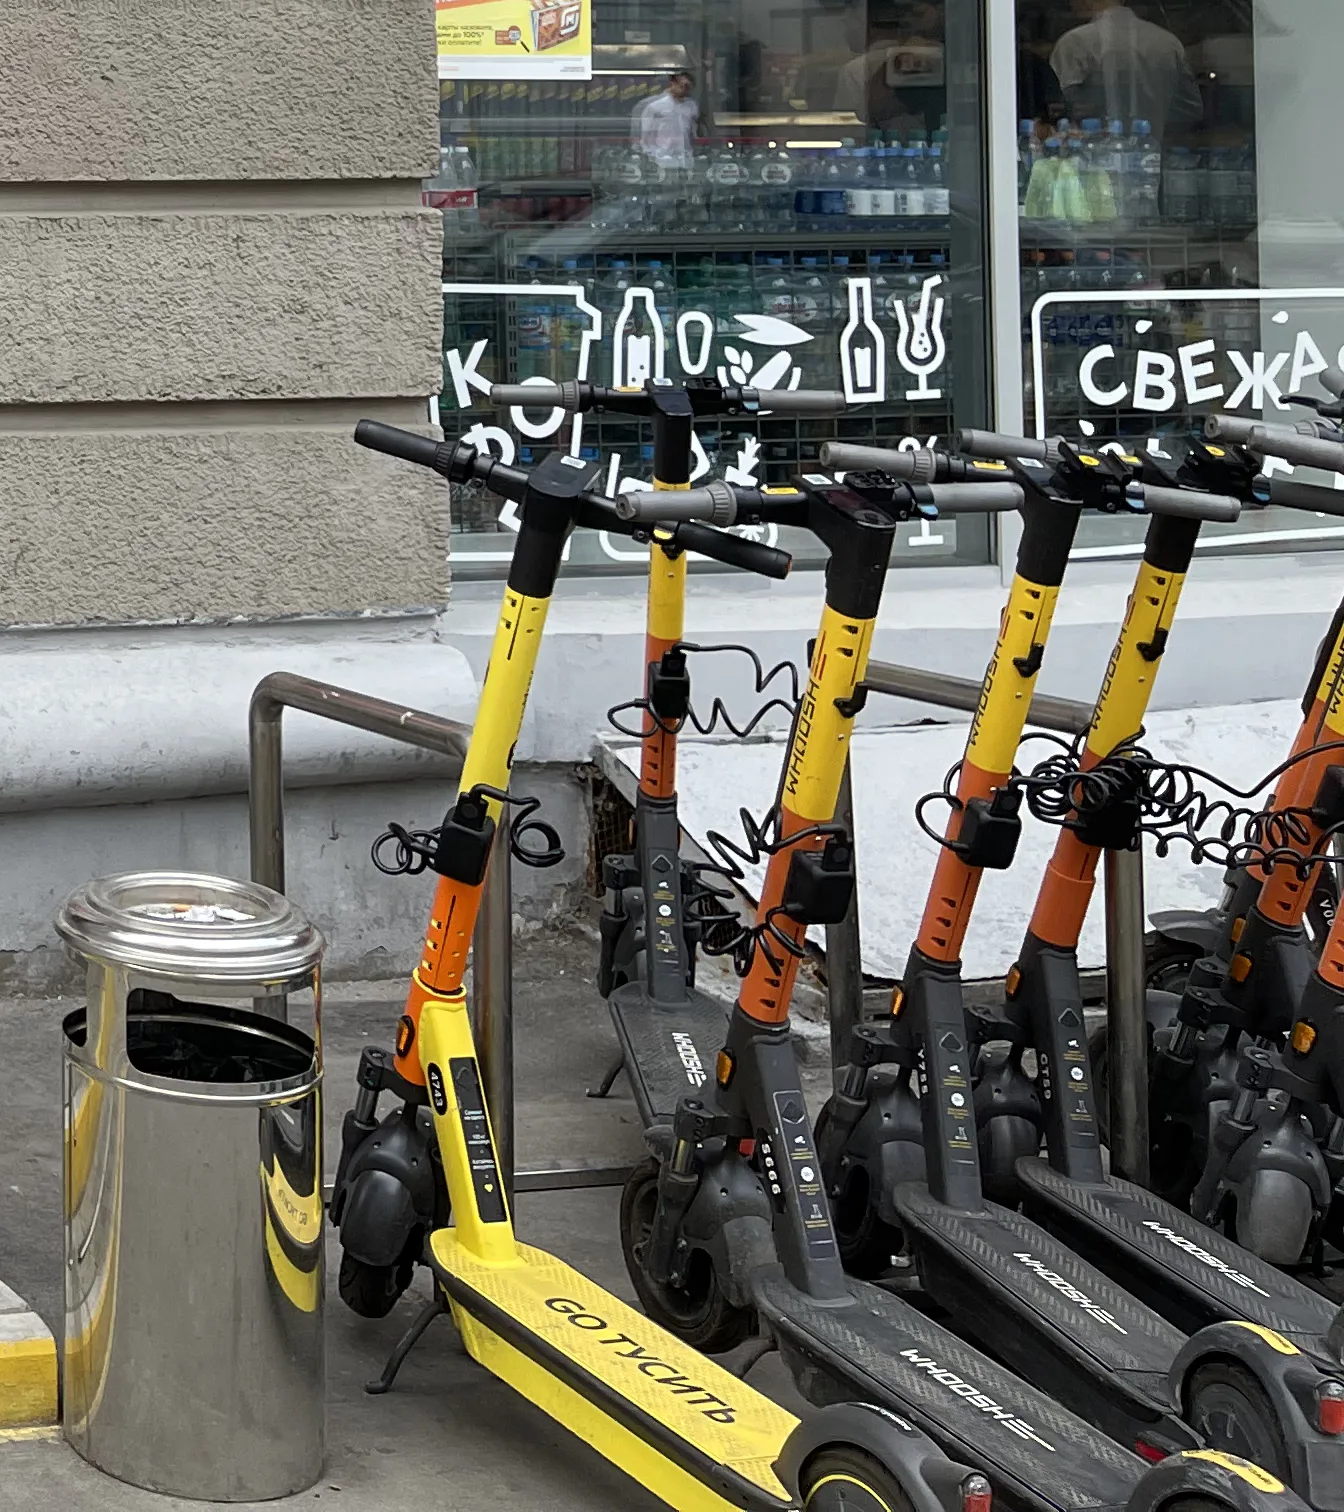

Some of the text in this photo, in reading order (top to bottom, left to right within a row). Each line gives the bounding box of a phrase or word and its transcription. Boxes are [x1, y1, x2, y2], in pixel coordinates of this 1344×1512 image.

[1079, 331, 1344, 412] СВЕЖА
[786, 679, 820, 795] WHOOSH
[544, 1297, 608, 1330] GO
[598, 1333, 737, 1424] ТУСИТЬ
[899, 1348, 1015, 1421] WHOOSH
